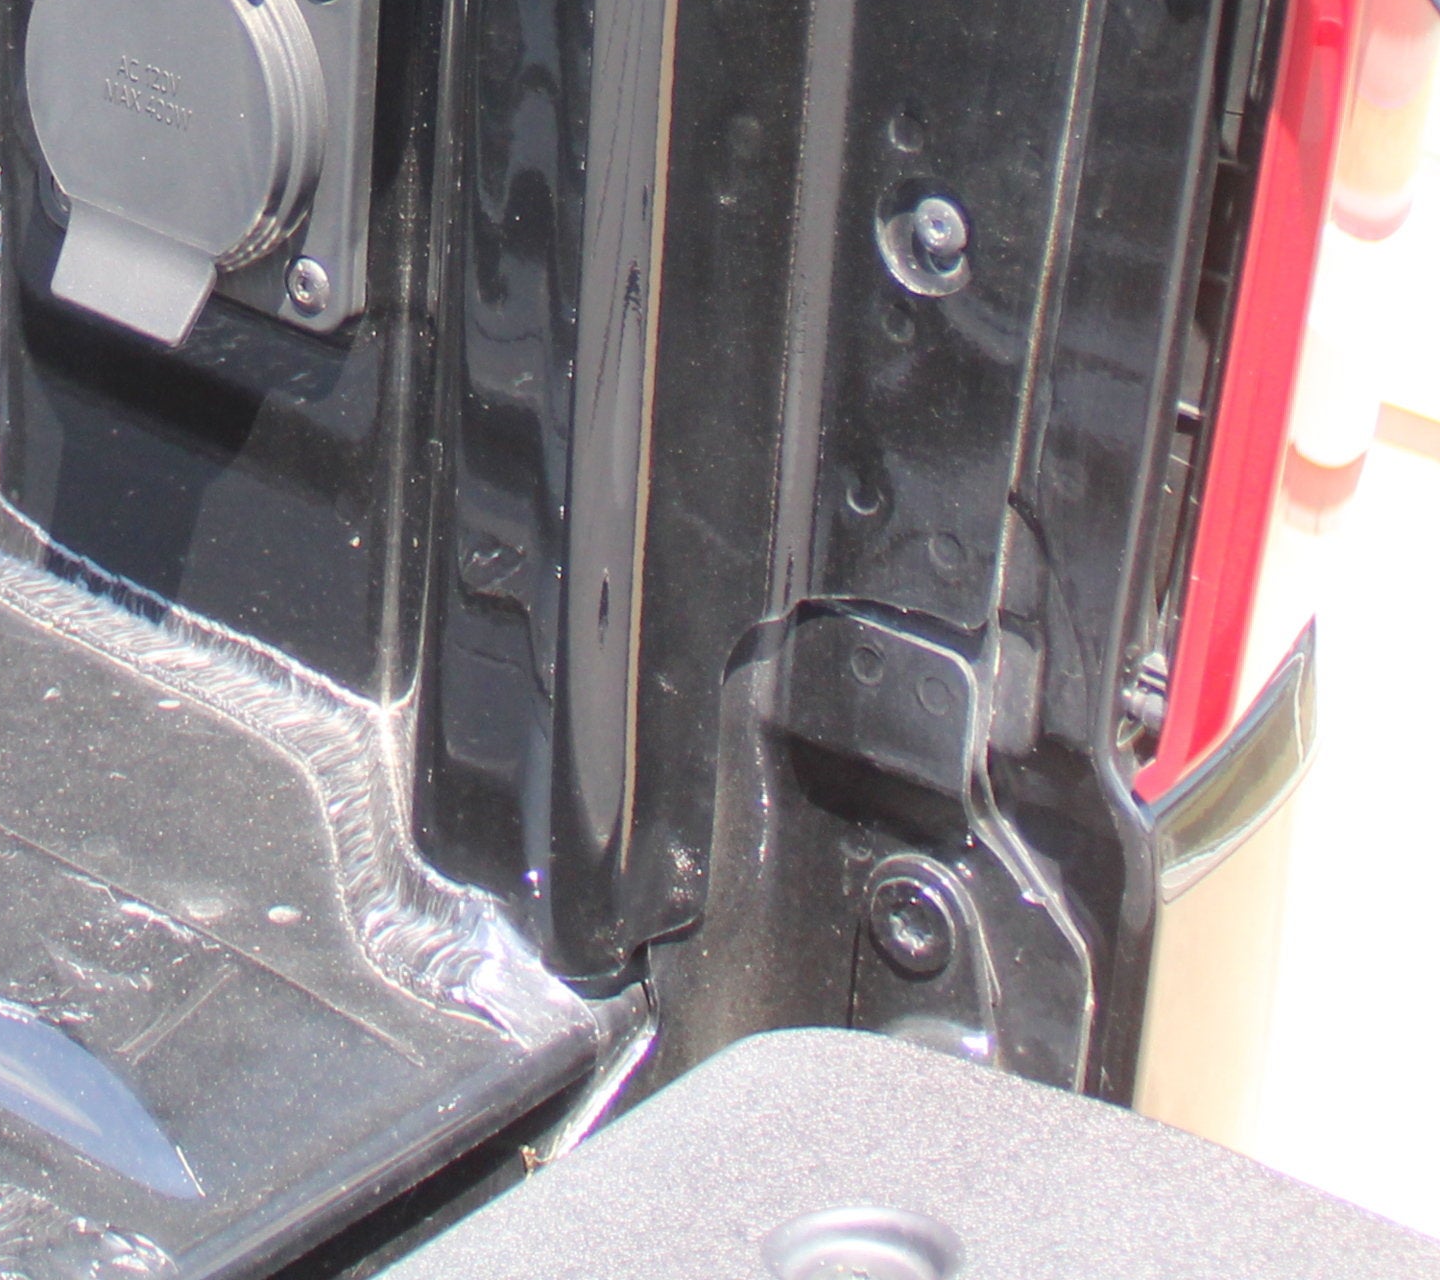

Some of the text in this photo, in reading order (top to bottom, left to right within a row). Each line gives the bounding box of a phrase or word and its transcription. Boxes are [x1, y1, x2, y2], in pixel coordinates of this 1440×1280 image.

[116, 54, 182, 98] AC 120V
[103, 77, 193, 131] MAX 400W
